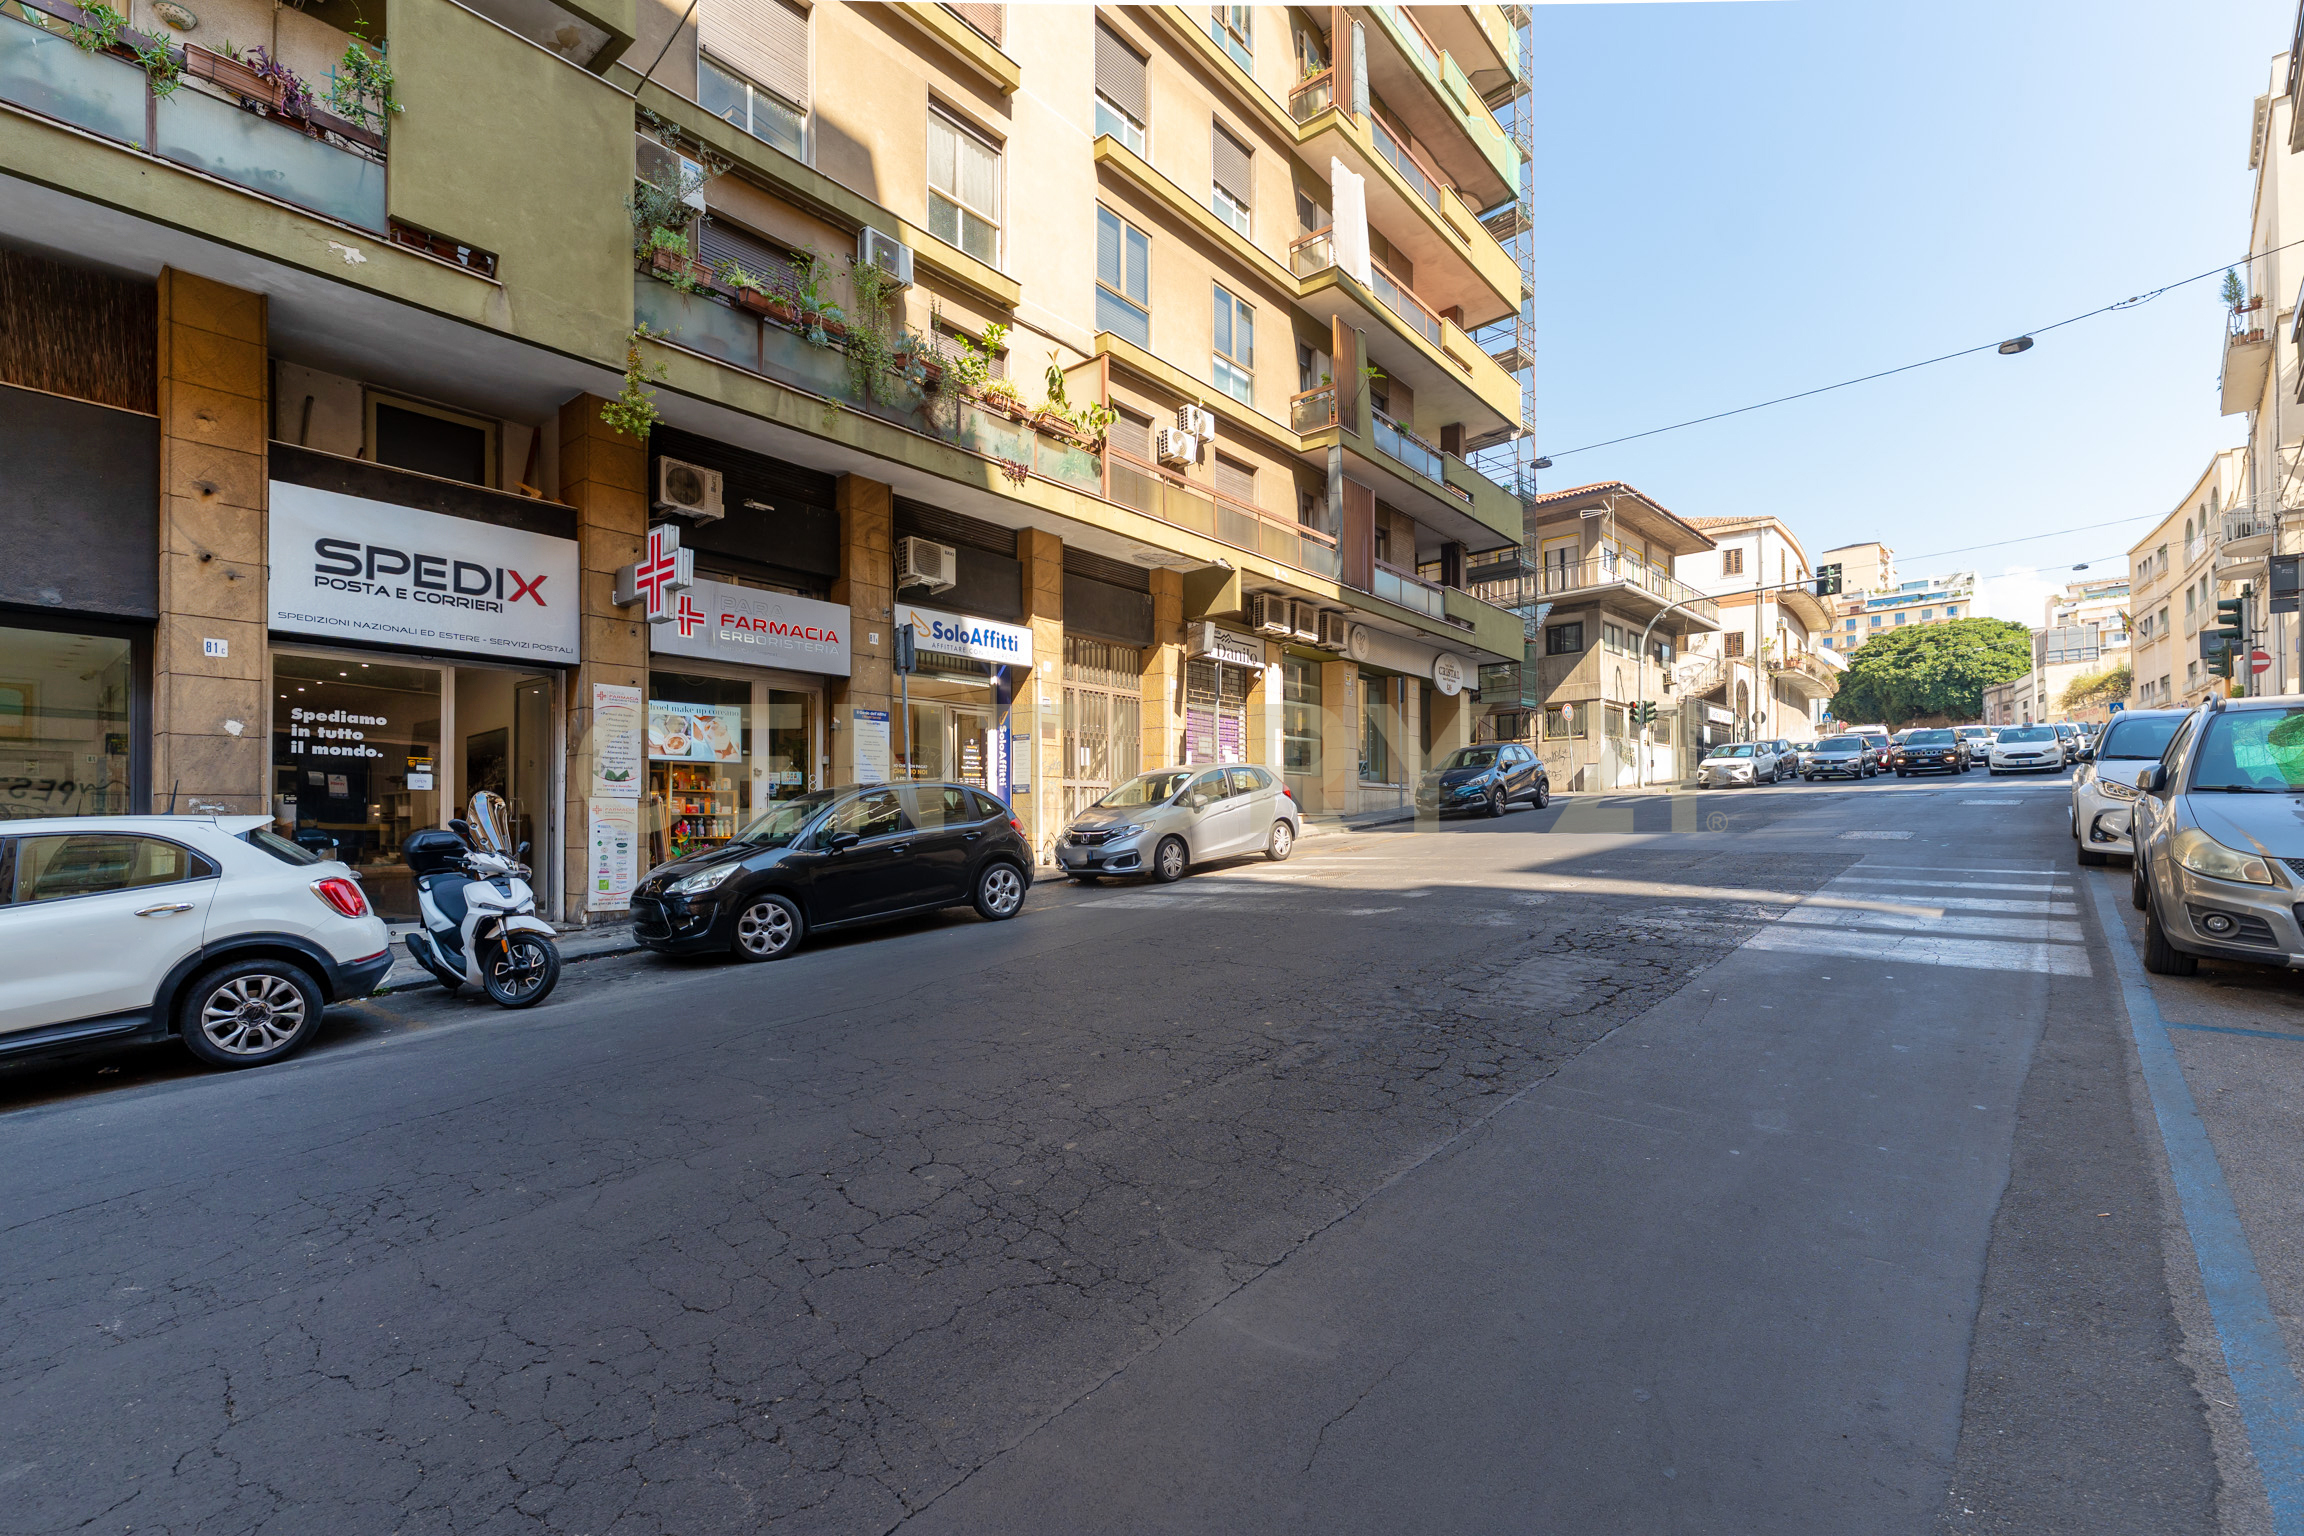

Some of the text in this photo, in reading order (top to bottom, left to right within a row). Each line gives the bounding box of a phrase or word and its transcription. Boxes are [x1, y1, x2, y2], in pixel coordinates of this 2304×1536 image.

[314, 538, 548, 606] SPEDIX
[315, 576, 503, 613] POSTA E CORRIERI
[720, 596, 785, 619] PARA
[277, 611, 350, 626] SPEDIZIONI
[353, 621, 418, 635] NAZIONALI
[420, 629, 435, 637] ED
[439, 631, 480, 643] ESTERE
[489, 638, 530, 649] SERVIZI
[533, 644, 573, 654] POSTALI
[721, 613, 839, 644] FARMACIA
[932, 621, 1018, 652] SoloAffitti
[720, 630, 839, 655] ERBORISTERIA
[932, 642, 966, 653] AFFITTARE
[1217, 643, 1257, 665] Danilo
[291, 708, 387, 725] Spediamo
[291, 724, 364, 740] in tutto
[291, 741, 383, 758] il mondo.
